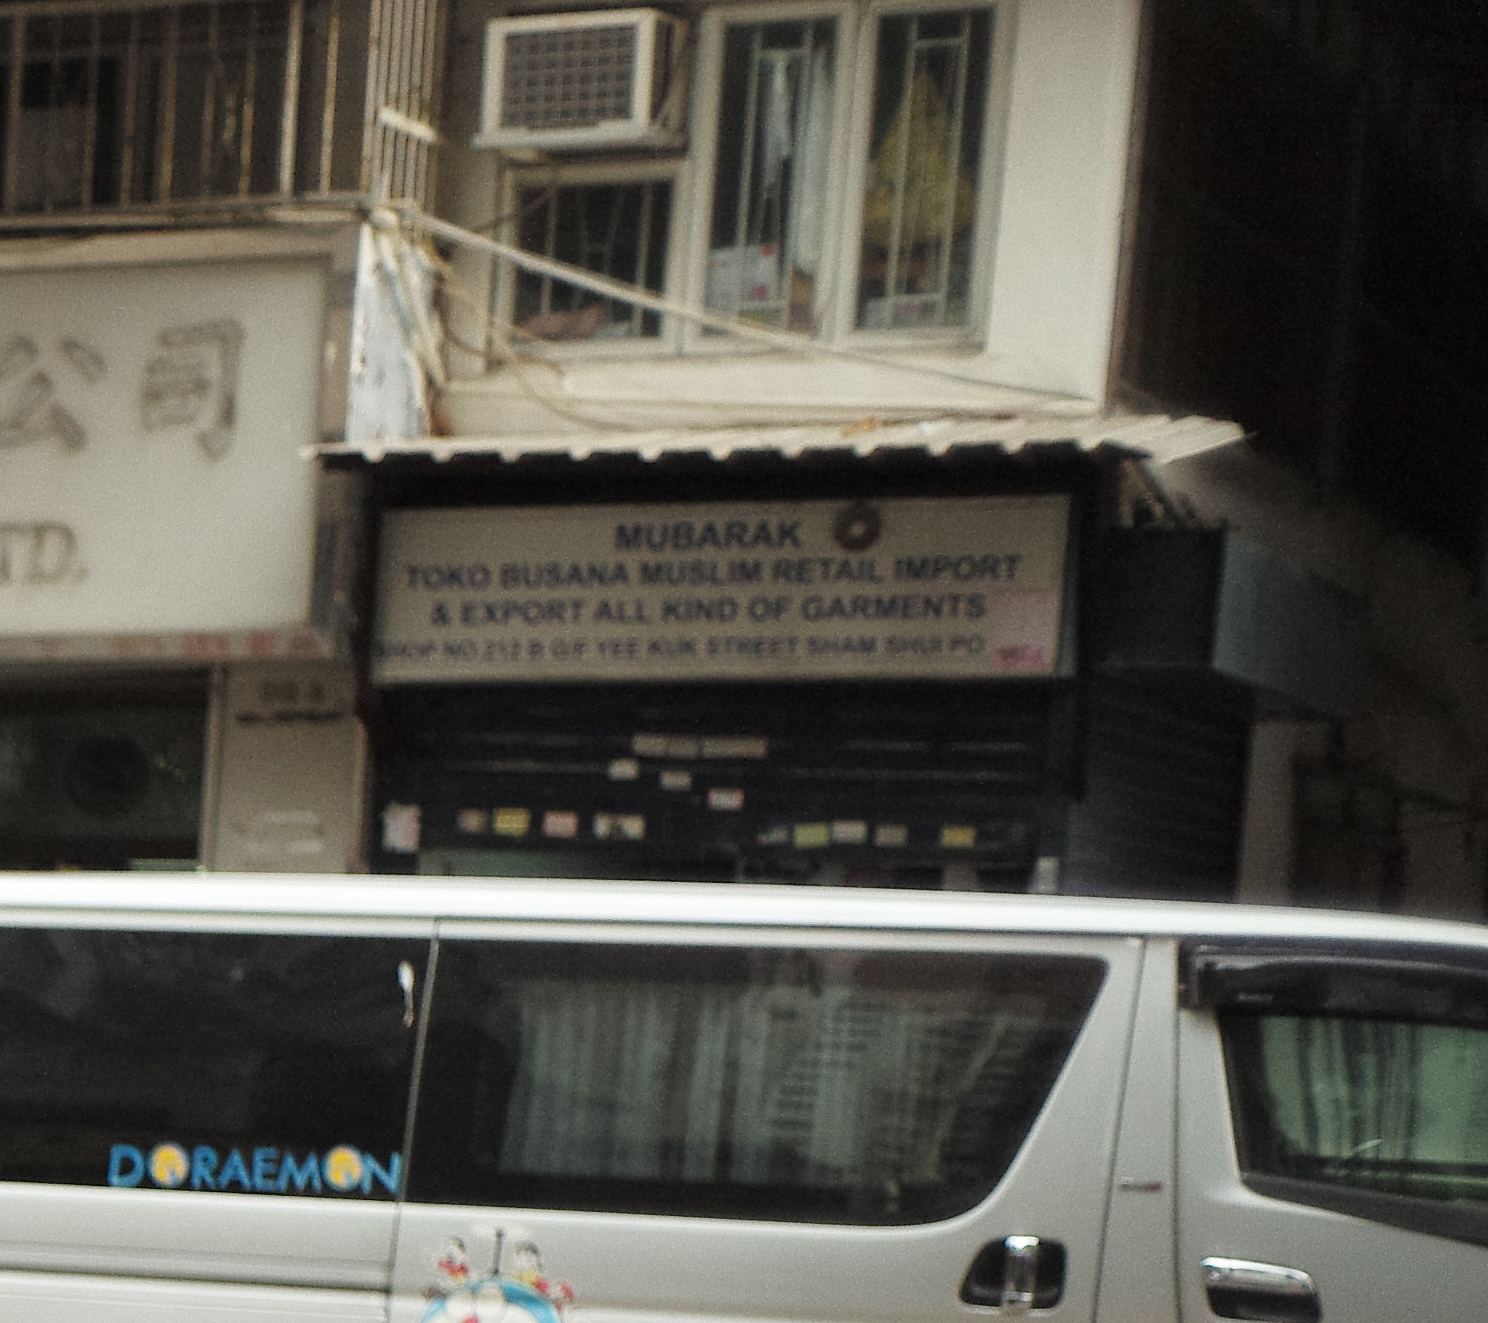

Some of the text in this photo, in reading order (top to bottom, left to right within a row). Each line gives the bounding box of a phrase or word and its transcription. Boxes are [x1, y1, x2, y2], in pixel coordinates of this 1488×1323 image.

[614, 520, 805, 552] MUBARAK
[499, 560, 630, 590] BUSANA
[638, 557, 765, 587] MUSLIM
[771, 556, 884, 585] RETAIL
[893, 553, 1024, 582] IMPORT
[460, 600, 585, 626] EXPORT
[592, 599, 653, 624] ALL
[661, 597, 738, 623] KIND
[748, 596, 792, 621] OF
[800, 593, 987, 621] GARMENTS
